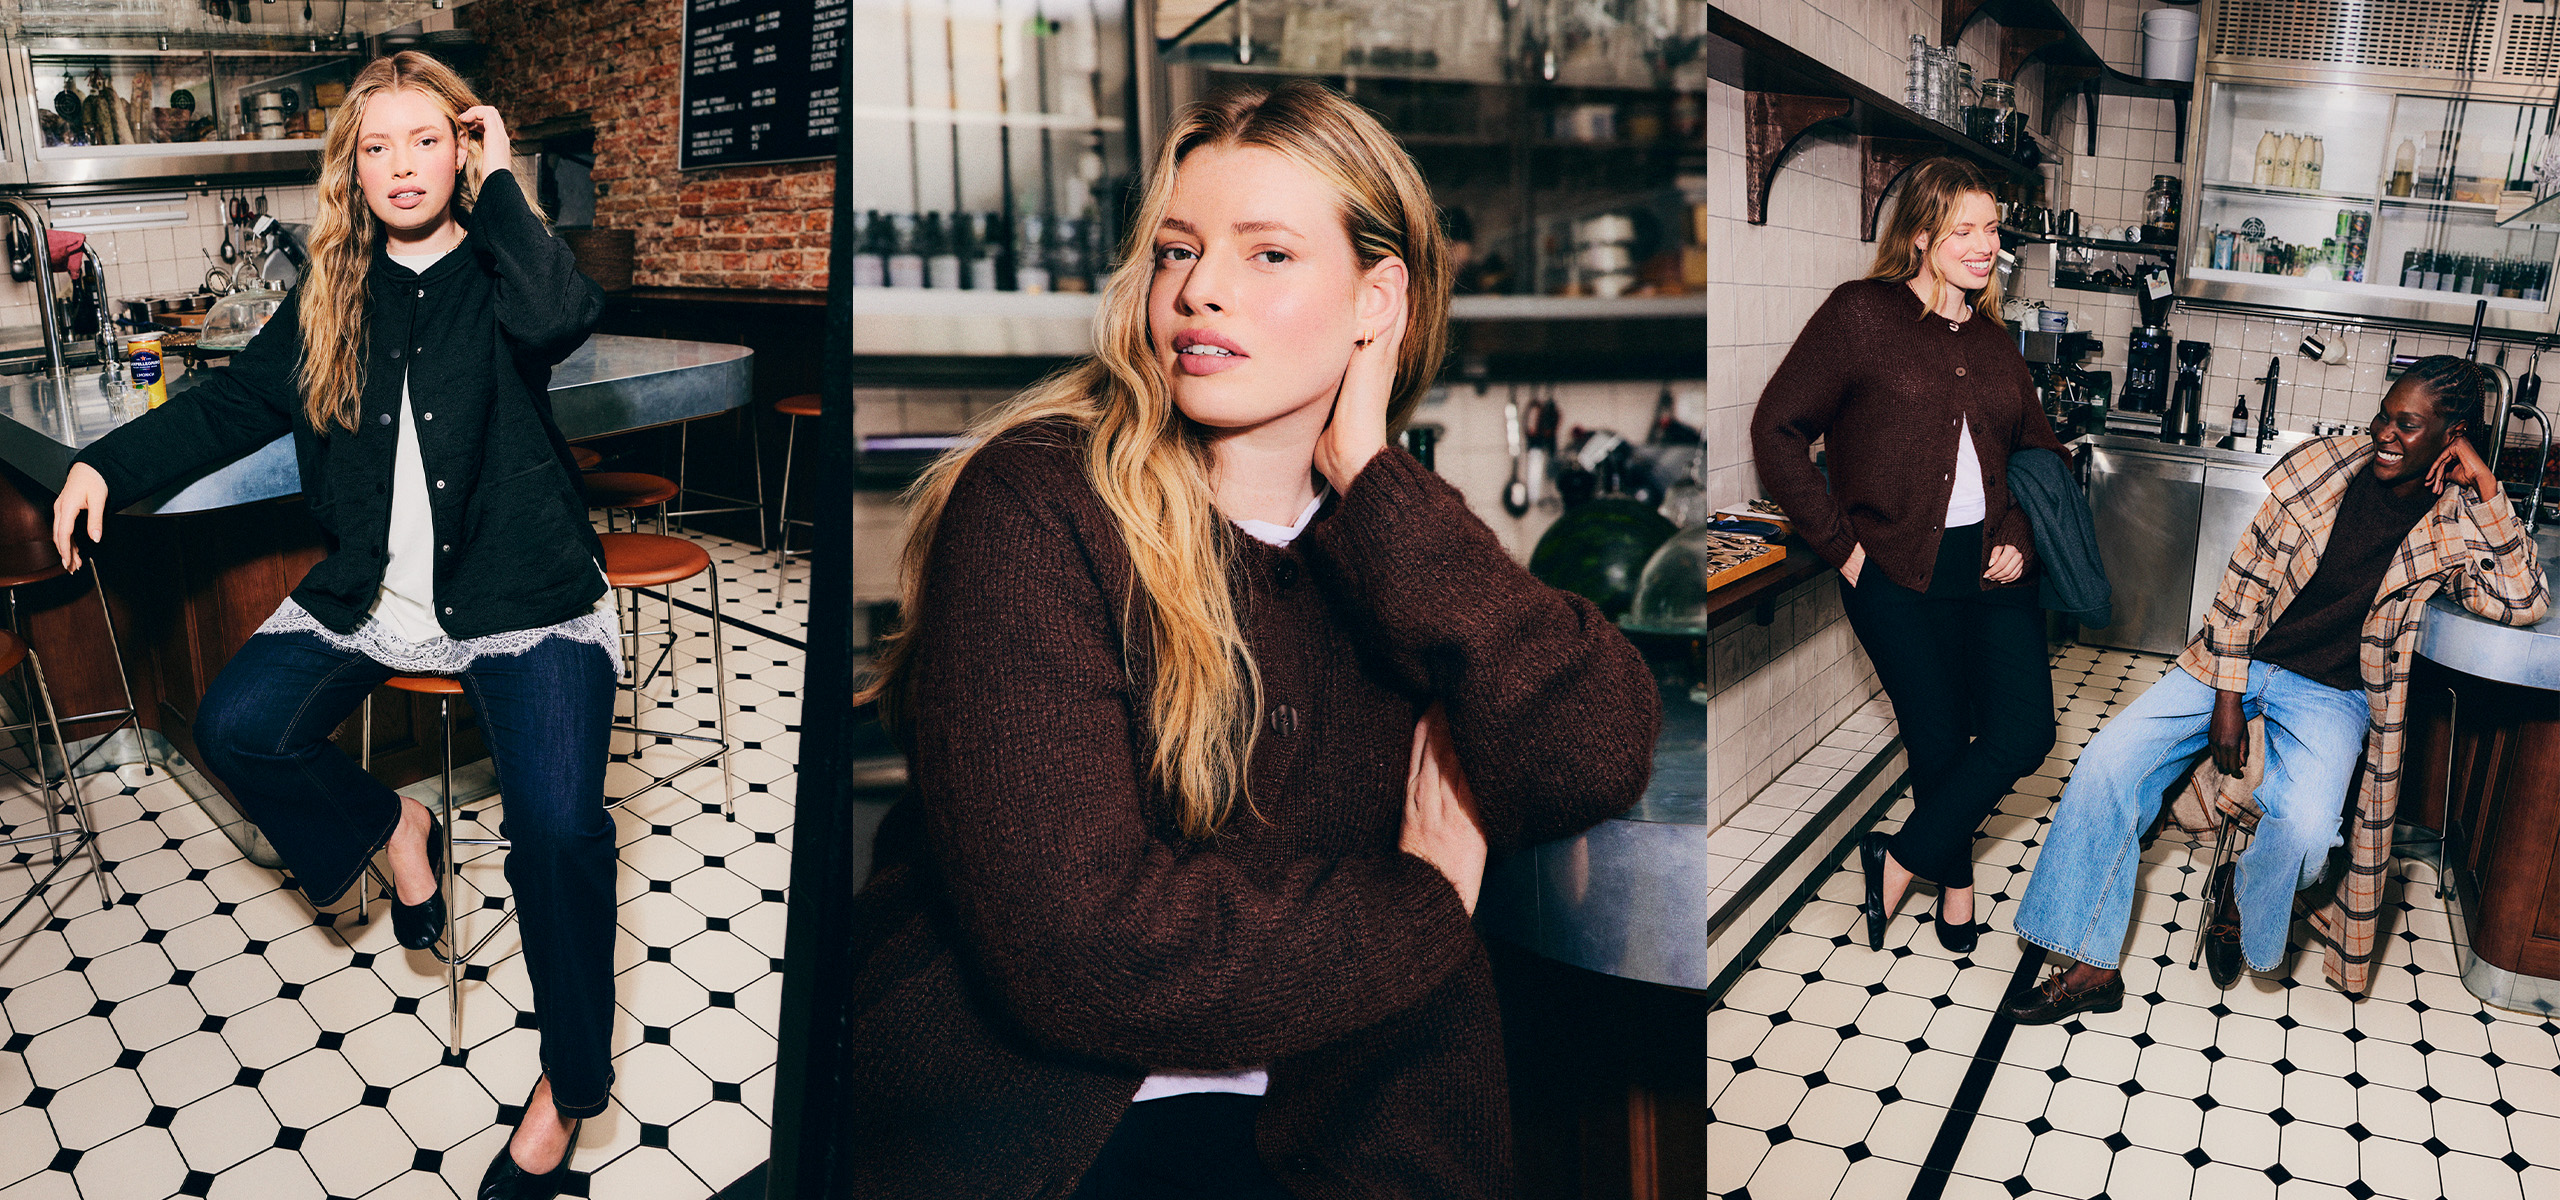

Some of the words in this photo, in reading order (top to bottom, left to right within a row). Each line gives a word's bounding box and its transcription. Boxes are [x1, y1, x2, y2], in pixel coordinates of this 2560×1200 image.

[812, 41, 827, 51] FINE
[829, 39, 838, 48] DE
[811, 50, 837, 61] SPECIAL
[810, 61, 833, 72] EDULIS
[810, 90, 821, 98] HOT
[809, 98, 839, 108] ESPRESSO
[809, 109, 819, 117] GIN
[809, 118, 834, 127] NEGRONI
[712, 128, 733, 137] CLASSIC
[808, 129, 821, 137] DRY
